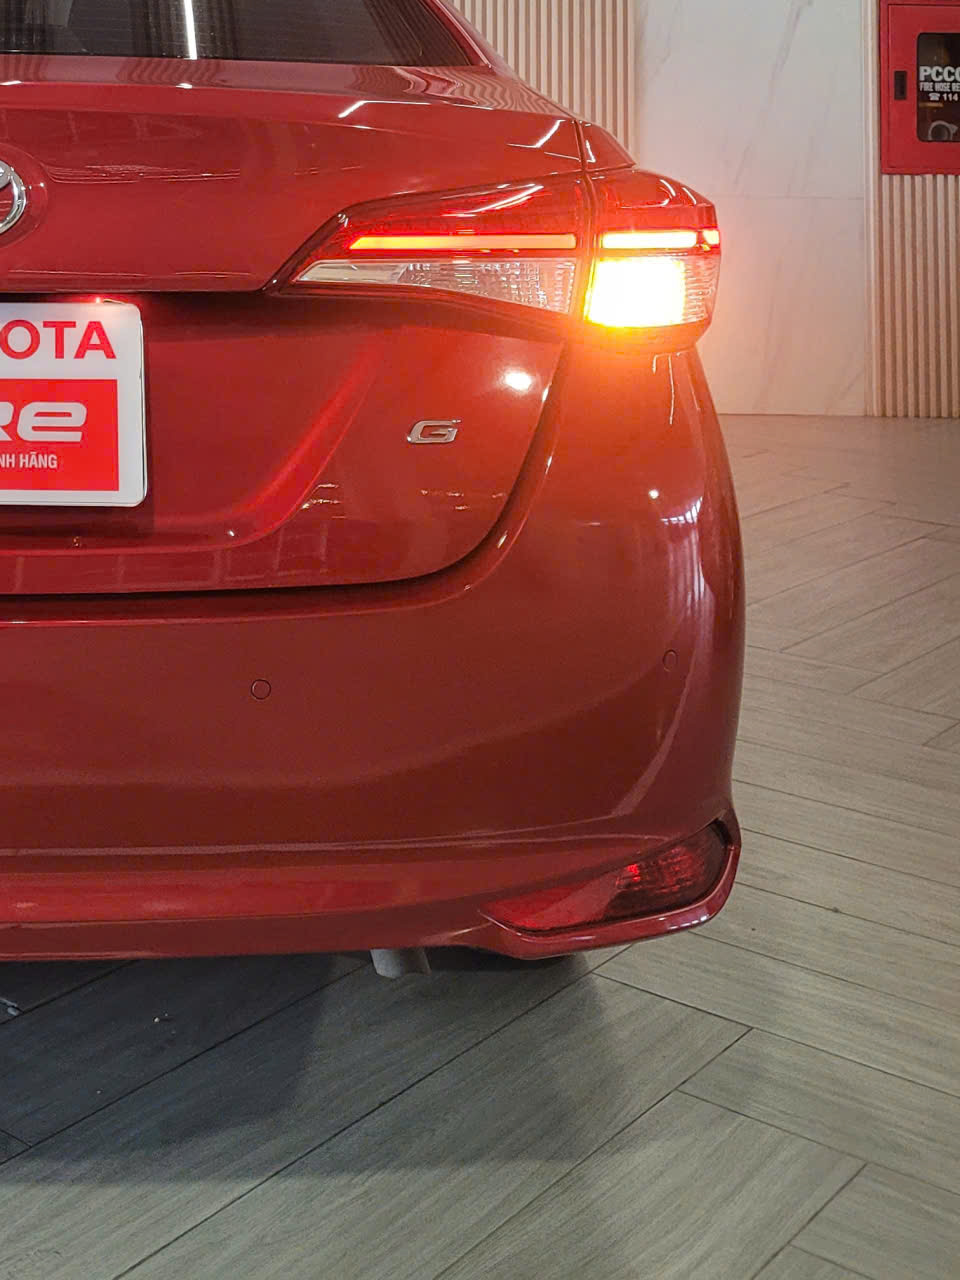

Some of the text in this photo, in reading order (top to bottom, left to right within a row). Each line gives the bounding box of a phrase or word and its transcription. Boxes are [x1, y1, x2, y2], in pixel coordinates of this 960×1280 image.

[942, 93, 959, 101] 114
[406, 419, 461, 444] G
[19, 451, 58, 469] HÃNG
